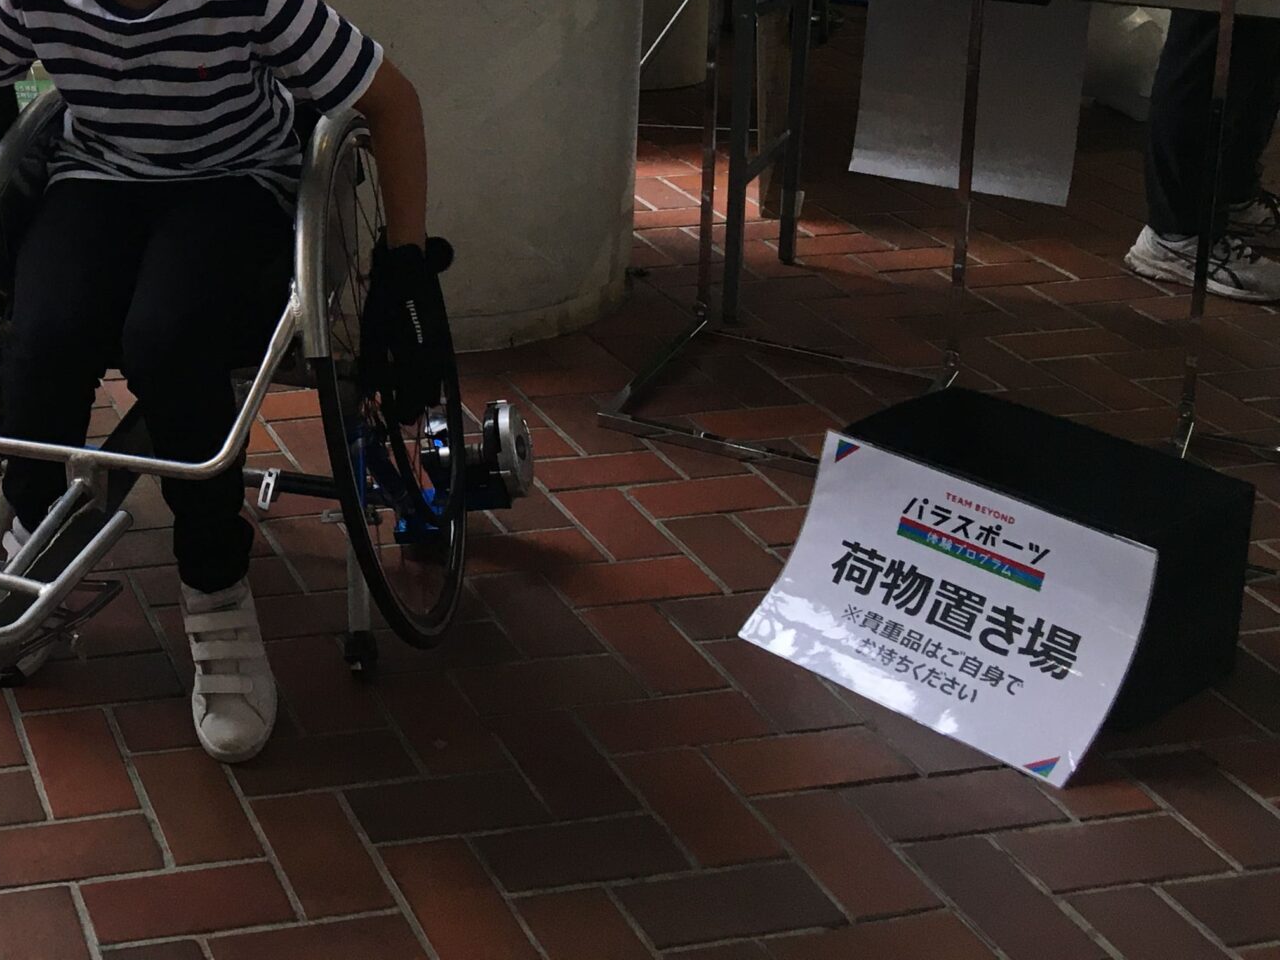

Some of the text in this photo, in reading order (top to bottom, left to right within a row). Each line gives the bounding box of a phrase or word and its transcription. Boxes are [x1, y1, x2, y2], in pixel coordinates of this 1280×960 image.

[902, 497, 1051, 566] パラスポーツ
[945, 492, 1016, 526] TEAM BEYOND
[925, 530, 1015, 579] 体験プログラム
[830, 540, 1083, 681] 荷物置き場
[841, 603, 1026, 698] ※貴重品はご自身で
[854, 638, 979, 705] お持ちください
